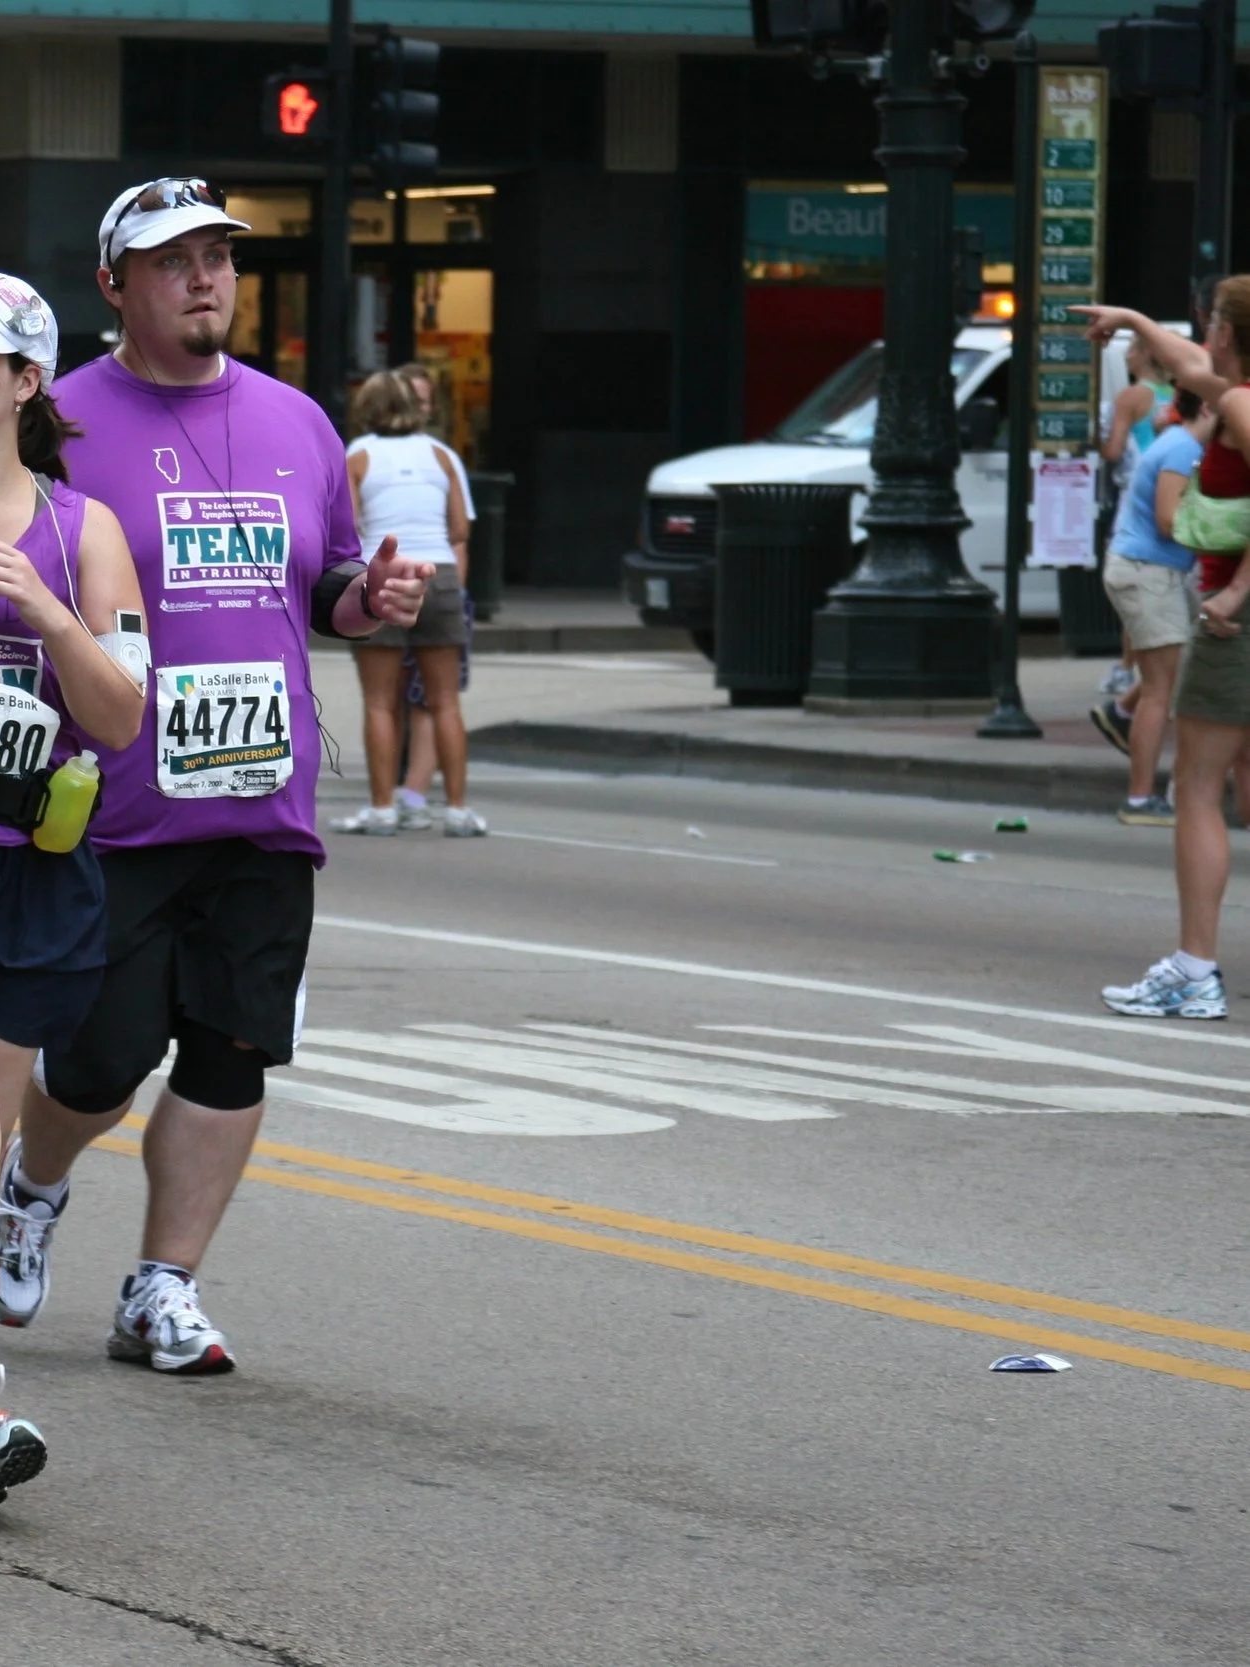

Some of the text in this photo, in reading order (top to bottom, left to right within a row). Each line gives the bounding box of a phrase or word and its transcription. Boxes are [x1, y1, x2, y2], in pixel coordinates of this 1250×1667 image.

[1049, 147, 1059, 168] 2
[1045, 186, 1064, 206] 10
[787, 198, 887, 236] Beaut
[1045, 225, 1064, 244] 29
[1041, 262, 1068, 281] 144
[1041, 304, 1067, 322] 145
[1039, 342, 1067, 361] 146
[1039, 380, 1064, 398] 147
[1037, 419, 1065, 438] 148
[198, 501, 212, 510] The
[253, 501, 259, 509] &
[247, 509, 276, 519] Society
[167, 526, 286, 565] TEAM
[172, 568, 191, 580] IN
[200, 673, 270, 686] LaSalle Bank
[9, 695, 38, 711] Bank
[166, 695, 285, 747] 44774
[183, 746, 285, 770] 30th ANNIVERSARY
[174, 782, 199, 790] October
